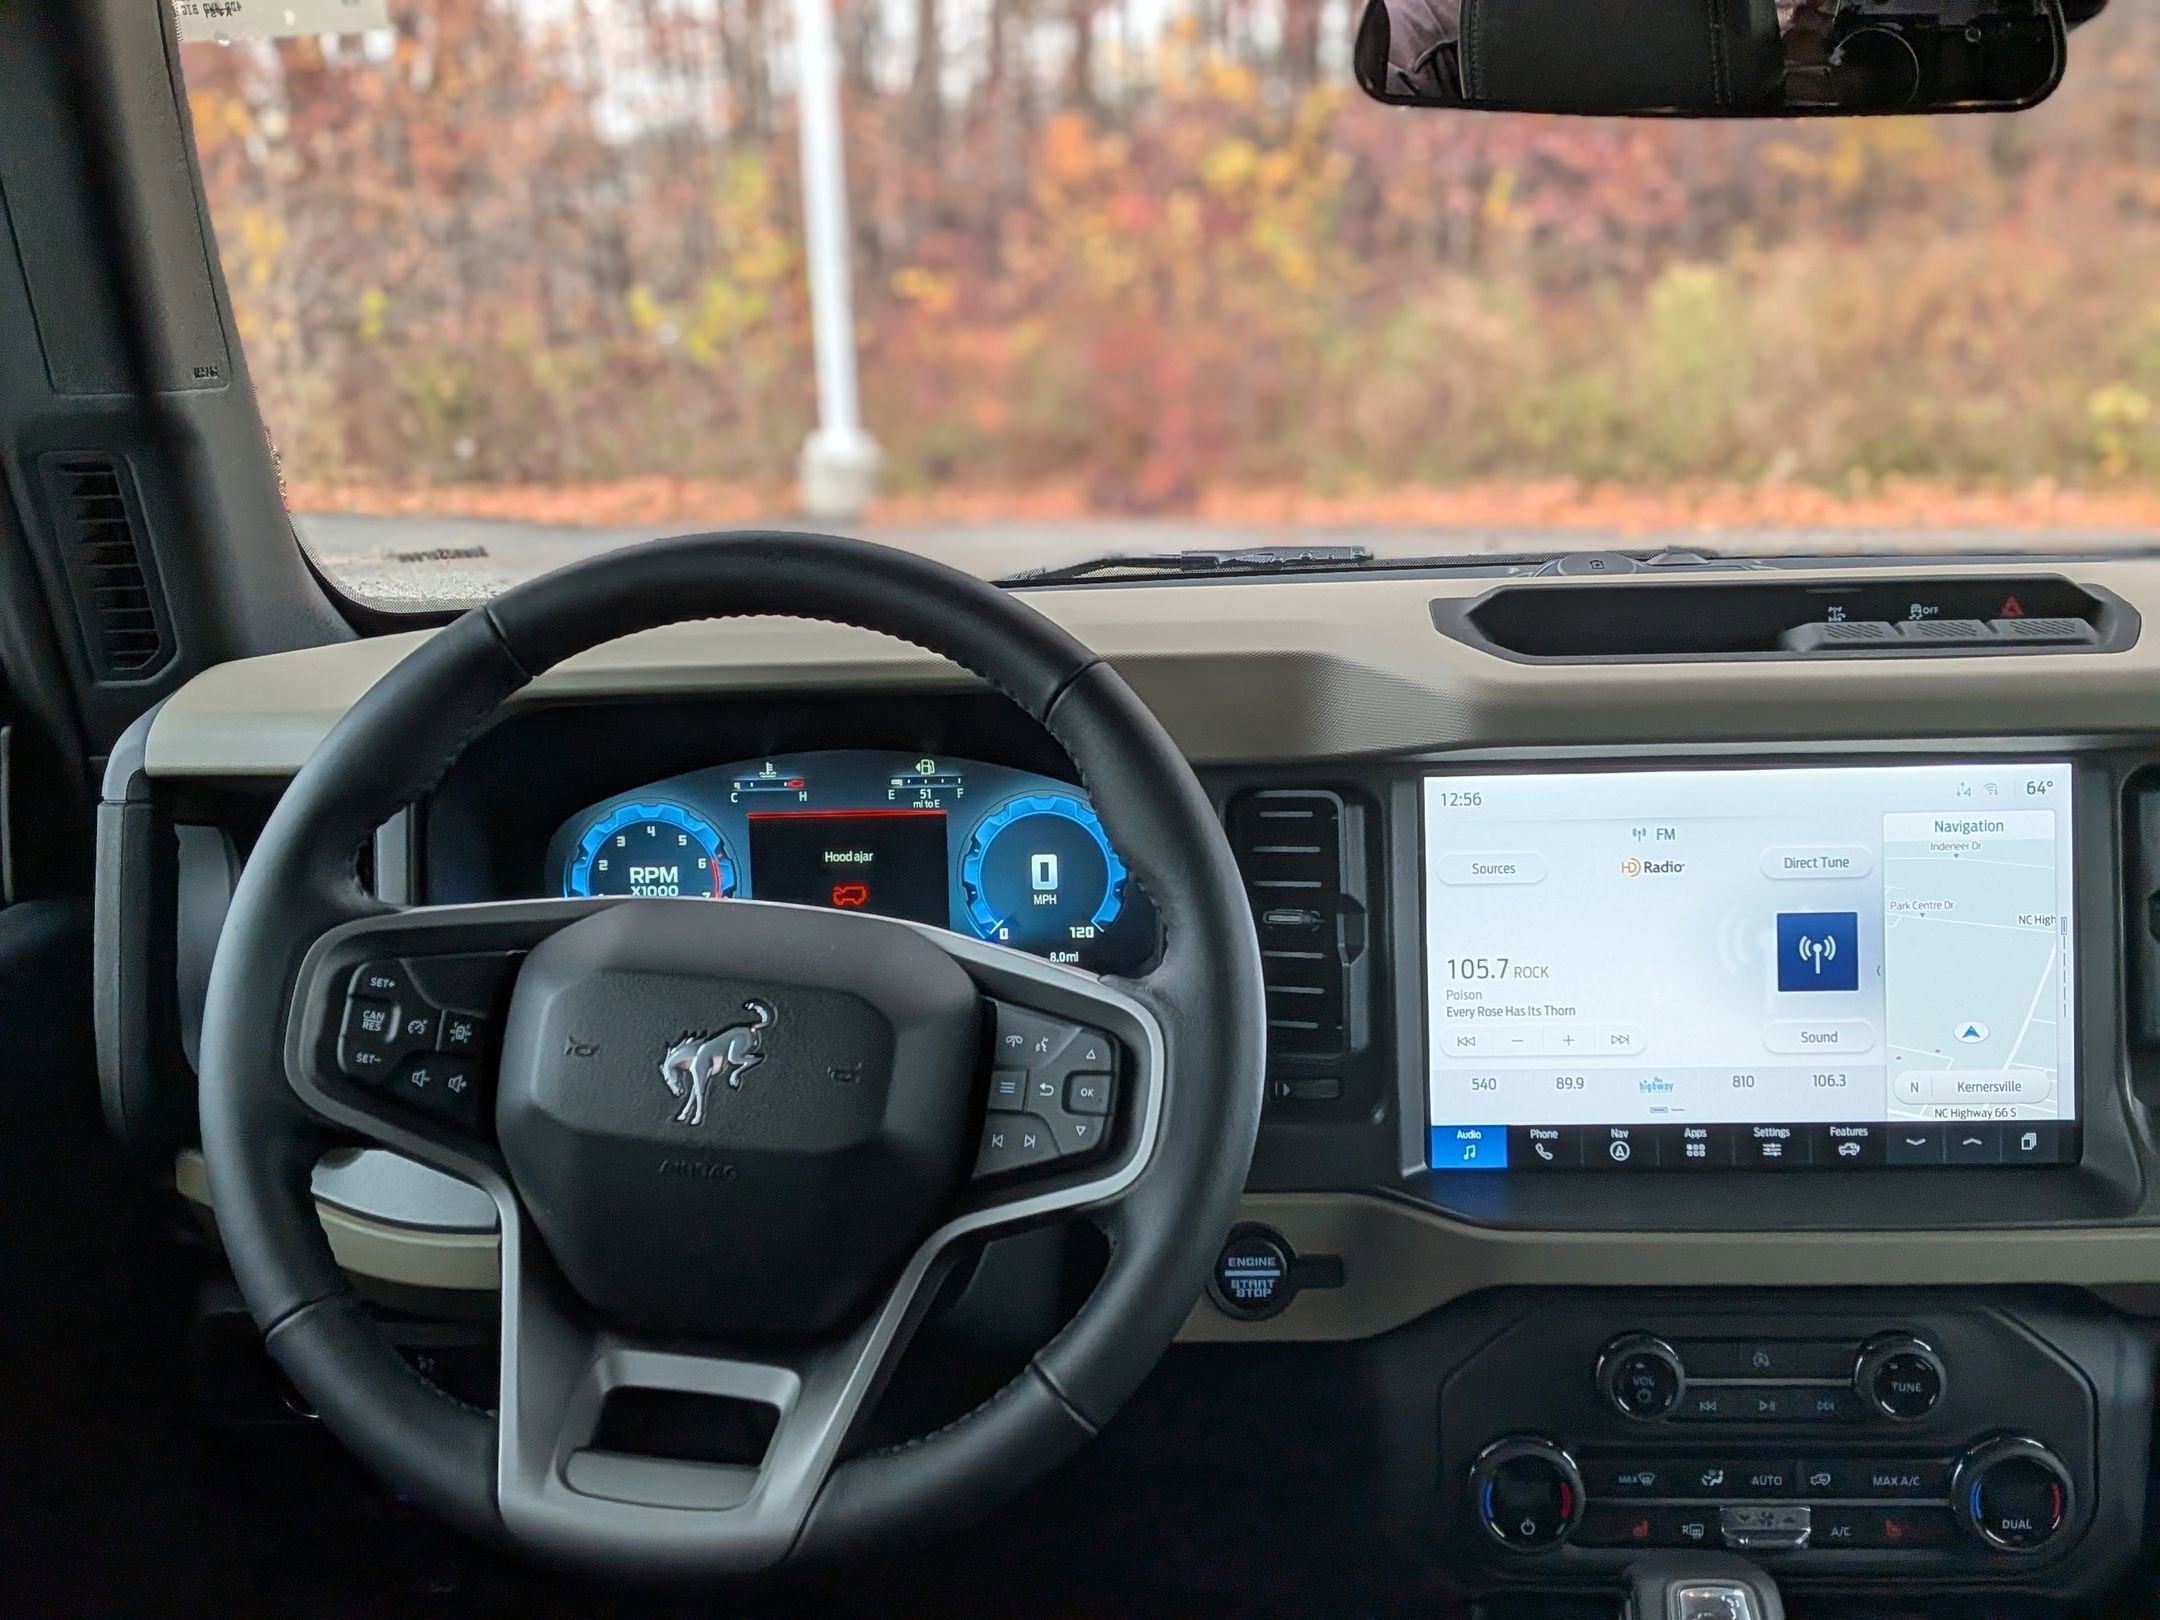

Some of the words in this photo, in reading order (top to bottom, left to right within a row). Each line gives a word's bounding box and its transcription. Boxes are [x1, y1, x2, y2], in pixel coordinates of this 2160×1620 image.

[1923, 606, 1939, 615] OFF
[956, 788, 963, 798] F
[2026, 780, 2054, 795] 64°
[731, 792, 738, 802] C
[799, 791, 807, 801] H
[888, 789, 895, 799] E
[919, 789, 931, 799] 51
[1440, 792, 1482, 807] 12:56
[934, 800, 940, 808] E
[647, 826, 656, 837] 4
[1934, 819, 2004, 834] Navigation
[1656, 828, 1676, 840] FM
[616, 836, 626, 847] 3
[678, 835, 687, 846] 5
[1971, 841, 1982, 850] Dr
[697, 857, 706, 869] 6
[824, 850, 851, 863] Hood
[853, 850, 874, 866] ajar
[1784, 856, 1818, 869] Direct
[1820, 856, 1850, 869] Tune
[599, 859, 608, 870] 2
[1472, 862, 1516, 876] Sources
[629, 866, 679, 884] RPM
[1031, 854, 1058, 890] 0
[630, 885, 679, 897] X1000
[1033, 894, 1058, 905] MPH
[1890, 901, 1911, 911] Park
[1912, 901, 1942, 911] Centre
[1944, 900, 1954, 910] Dr
[2018, 914, 2033, 925] NC
[999, 928, 1009, 940] 0
[1069, 926, 1095, 939] 120
[1447, 958, 1509, 979] 105.7
[1514, 966, 1549, 978] ROCK
[1446, 989, 1482, 1001] Poison
[363, 1010, 385, 1020] CAN
[1446, 1005, 1475, 1019] Every
[1477, 1005, 1503, 1017] Rose
[1505, 1004, 1526, 1016] Has
[1527, 1004, 1542, 1016] Its
[1544, 1003, 1576, 1016] Thorn
[362, 1021, 382, 1031] RES
[1800, 1030, 1839, 1043] Sound
[1471, 1077, 1497, 1090] 540
[1555, 1077, 1584, 1089] 89.9
[1639, 1079, 1674, 1093] highway
[1732, 1075, 1755, 1088] 810
[1812, 1075, 1847, 1087] 106.3
[1909, 1081, 1920, 1092] N
[1957, 1080, 2022, 1093] Kernersville
[1080, 1088, 1094, 1097] OK
[1934, 1107, 1949, 1118] NC
[1950, 1107, 1993, 1120] Highway
[1994, 1106, 2009, 1118] 66
[2010, 1107, 2017, 1117] S
[1456, 1129, 1482, 1140] Audio
[1529, 1128, 1559, 1140] Phone
[1611, 1128, 1629, 1139] Nav
[1684, 1127, 1707, 1140] Apps
[1753, 1126, 1791, 1138] Settings
[1830, 1126, 1869, 1137] Features
[1228, 1257, 1276, 1267] ENGINE
[1231, 1279, 1275, 1288] START
[1236, 1289, 1272, 1297] STOP
[1632, 1376, 1655, 1387] VOL
[1891, 1382, 1921, 1393] TUNE
[1751, 1475, 1782, 1486] AUTO
[1873, 1475, 1898, 1486] MAX
[1901, 1475, 1920, 1486] A/C
[1682, 1525, 1689, 1535] R
[2002, 1519, 2032, 1530] DUAL
[1831, 1526, 1851, 1536] A/C
